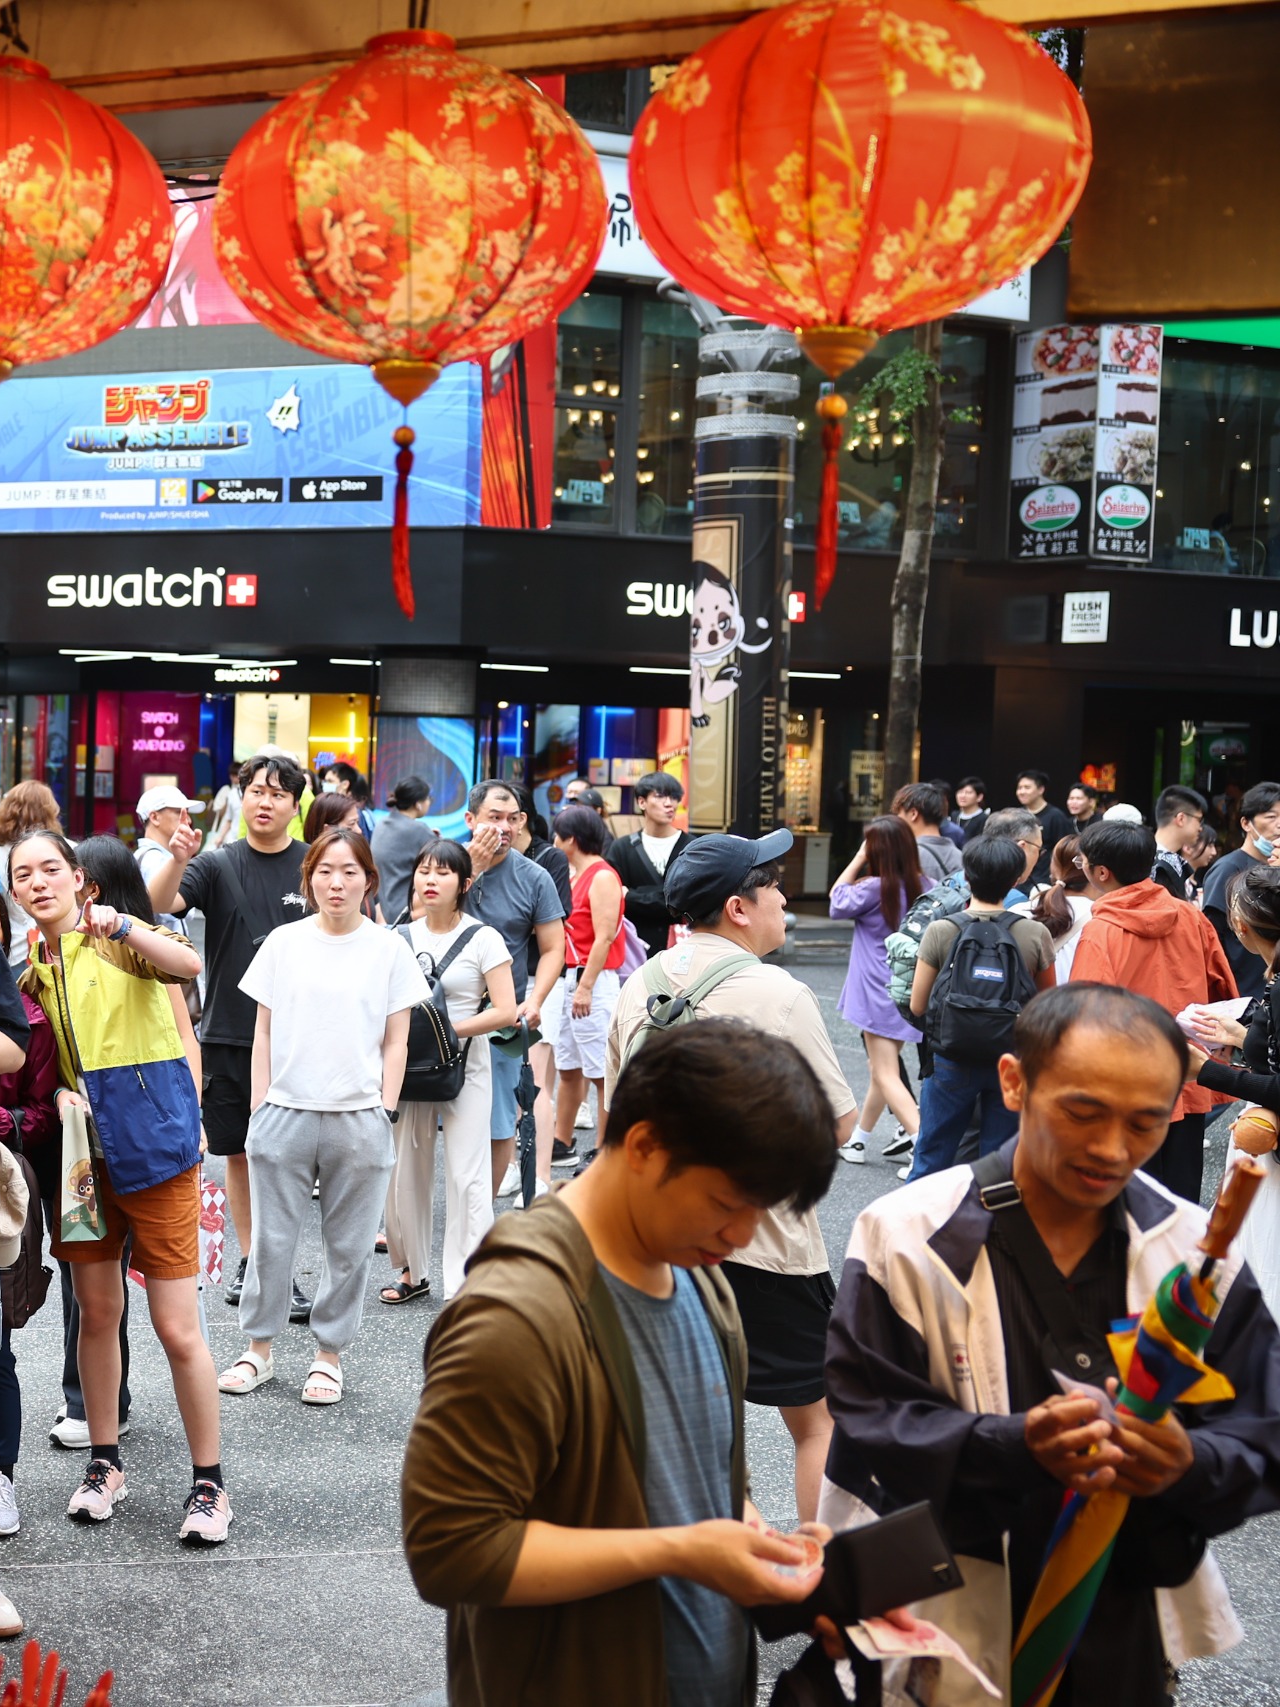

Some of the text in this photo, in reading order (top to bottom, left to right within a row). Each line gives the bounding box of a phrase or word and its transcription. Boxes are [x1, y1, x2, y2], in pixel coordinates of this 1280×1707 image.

[125, 424, 249, 450] ASSEMBLE
[320, 479, 367, 492] App Store
[218, 488, 279, 503] Google Play
[47, 567, 226, 607] swatch
[1072, 601, 1102, 611] LUSH
[1230, 608, 1280, 648] LU
[214, 668, 270, 682] swatch
[141, 711, 179, 724] SWATCH
[760, 697, 776, 832] HELLO TAIPEI
